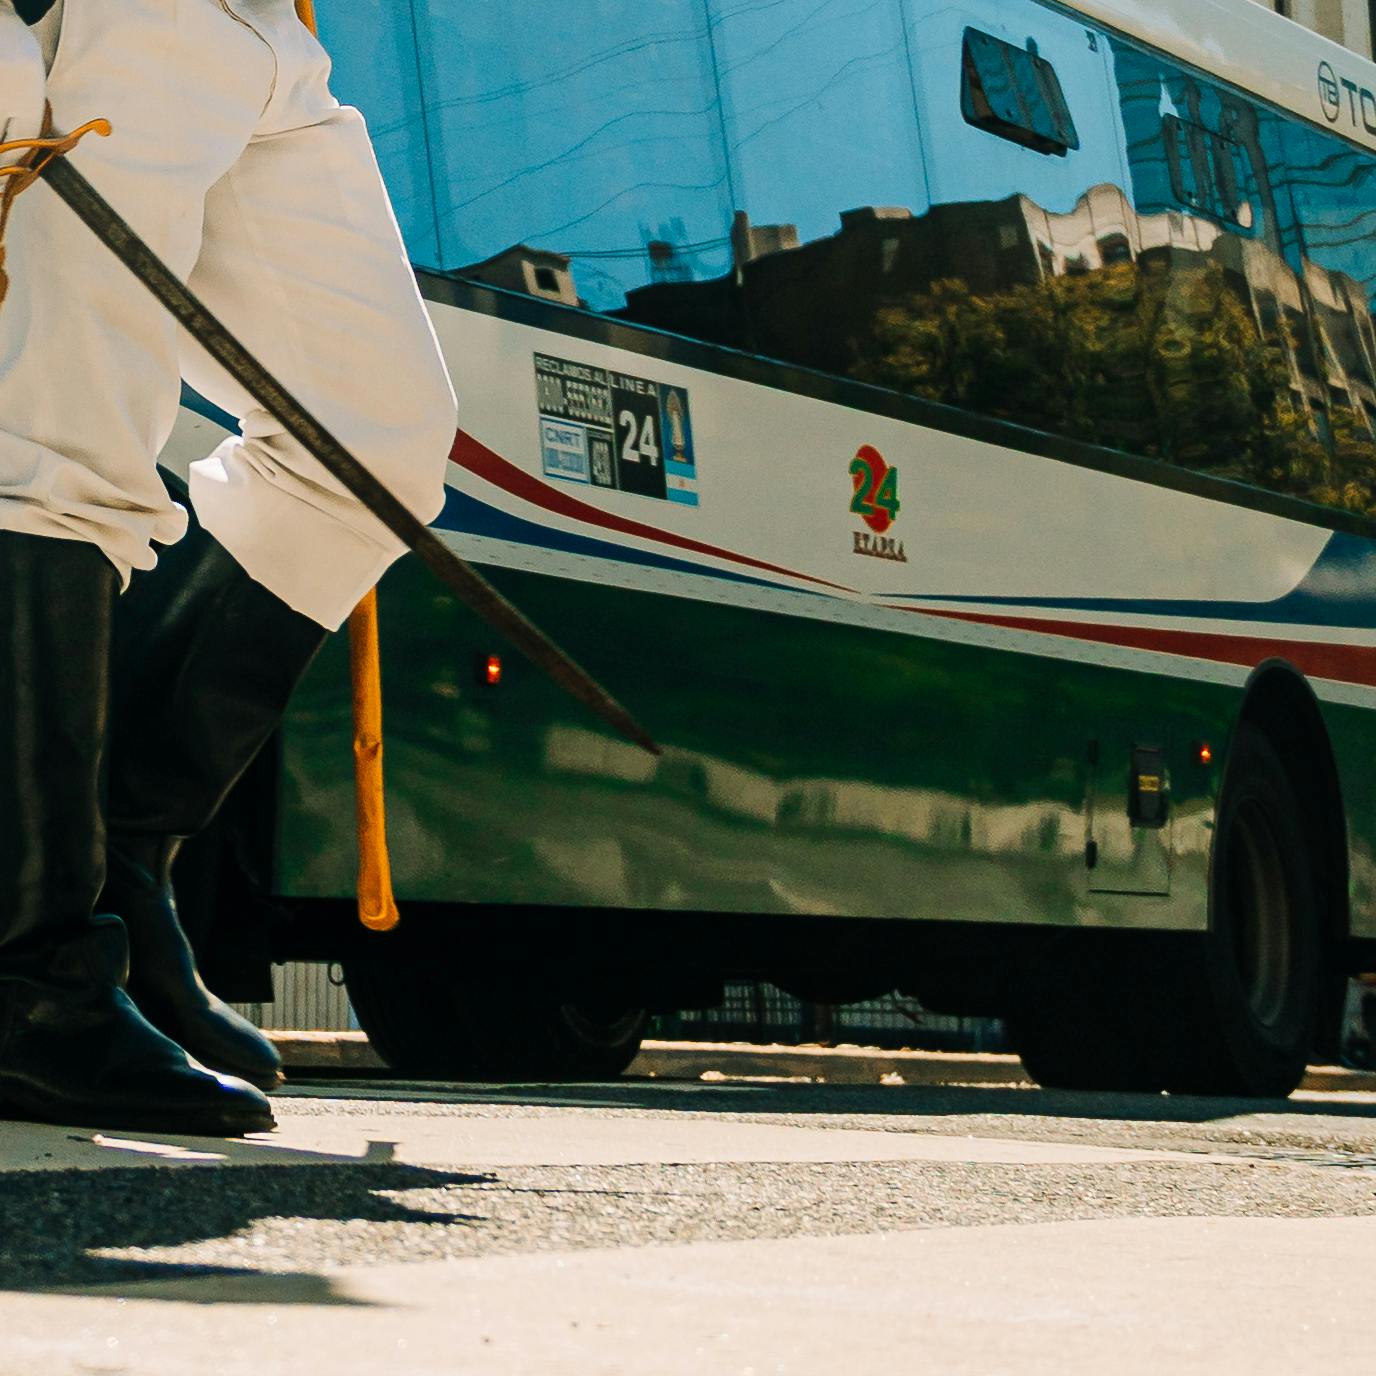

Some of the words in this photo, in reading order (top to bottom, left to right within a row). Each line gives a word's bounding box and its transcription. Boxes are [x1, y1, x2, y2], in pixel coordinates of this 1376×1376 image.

[610, 375, 657, 397] LINEA
[619, 410, 659, 467] 24
[849, 457, 900, 521] 24
